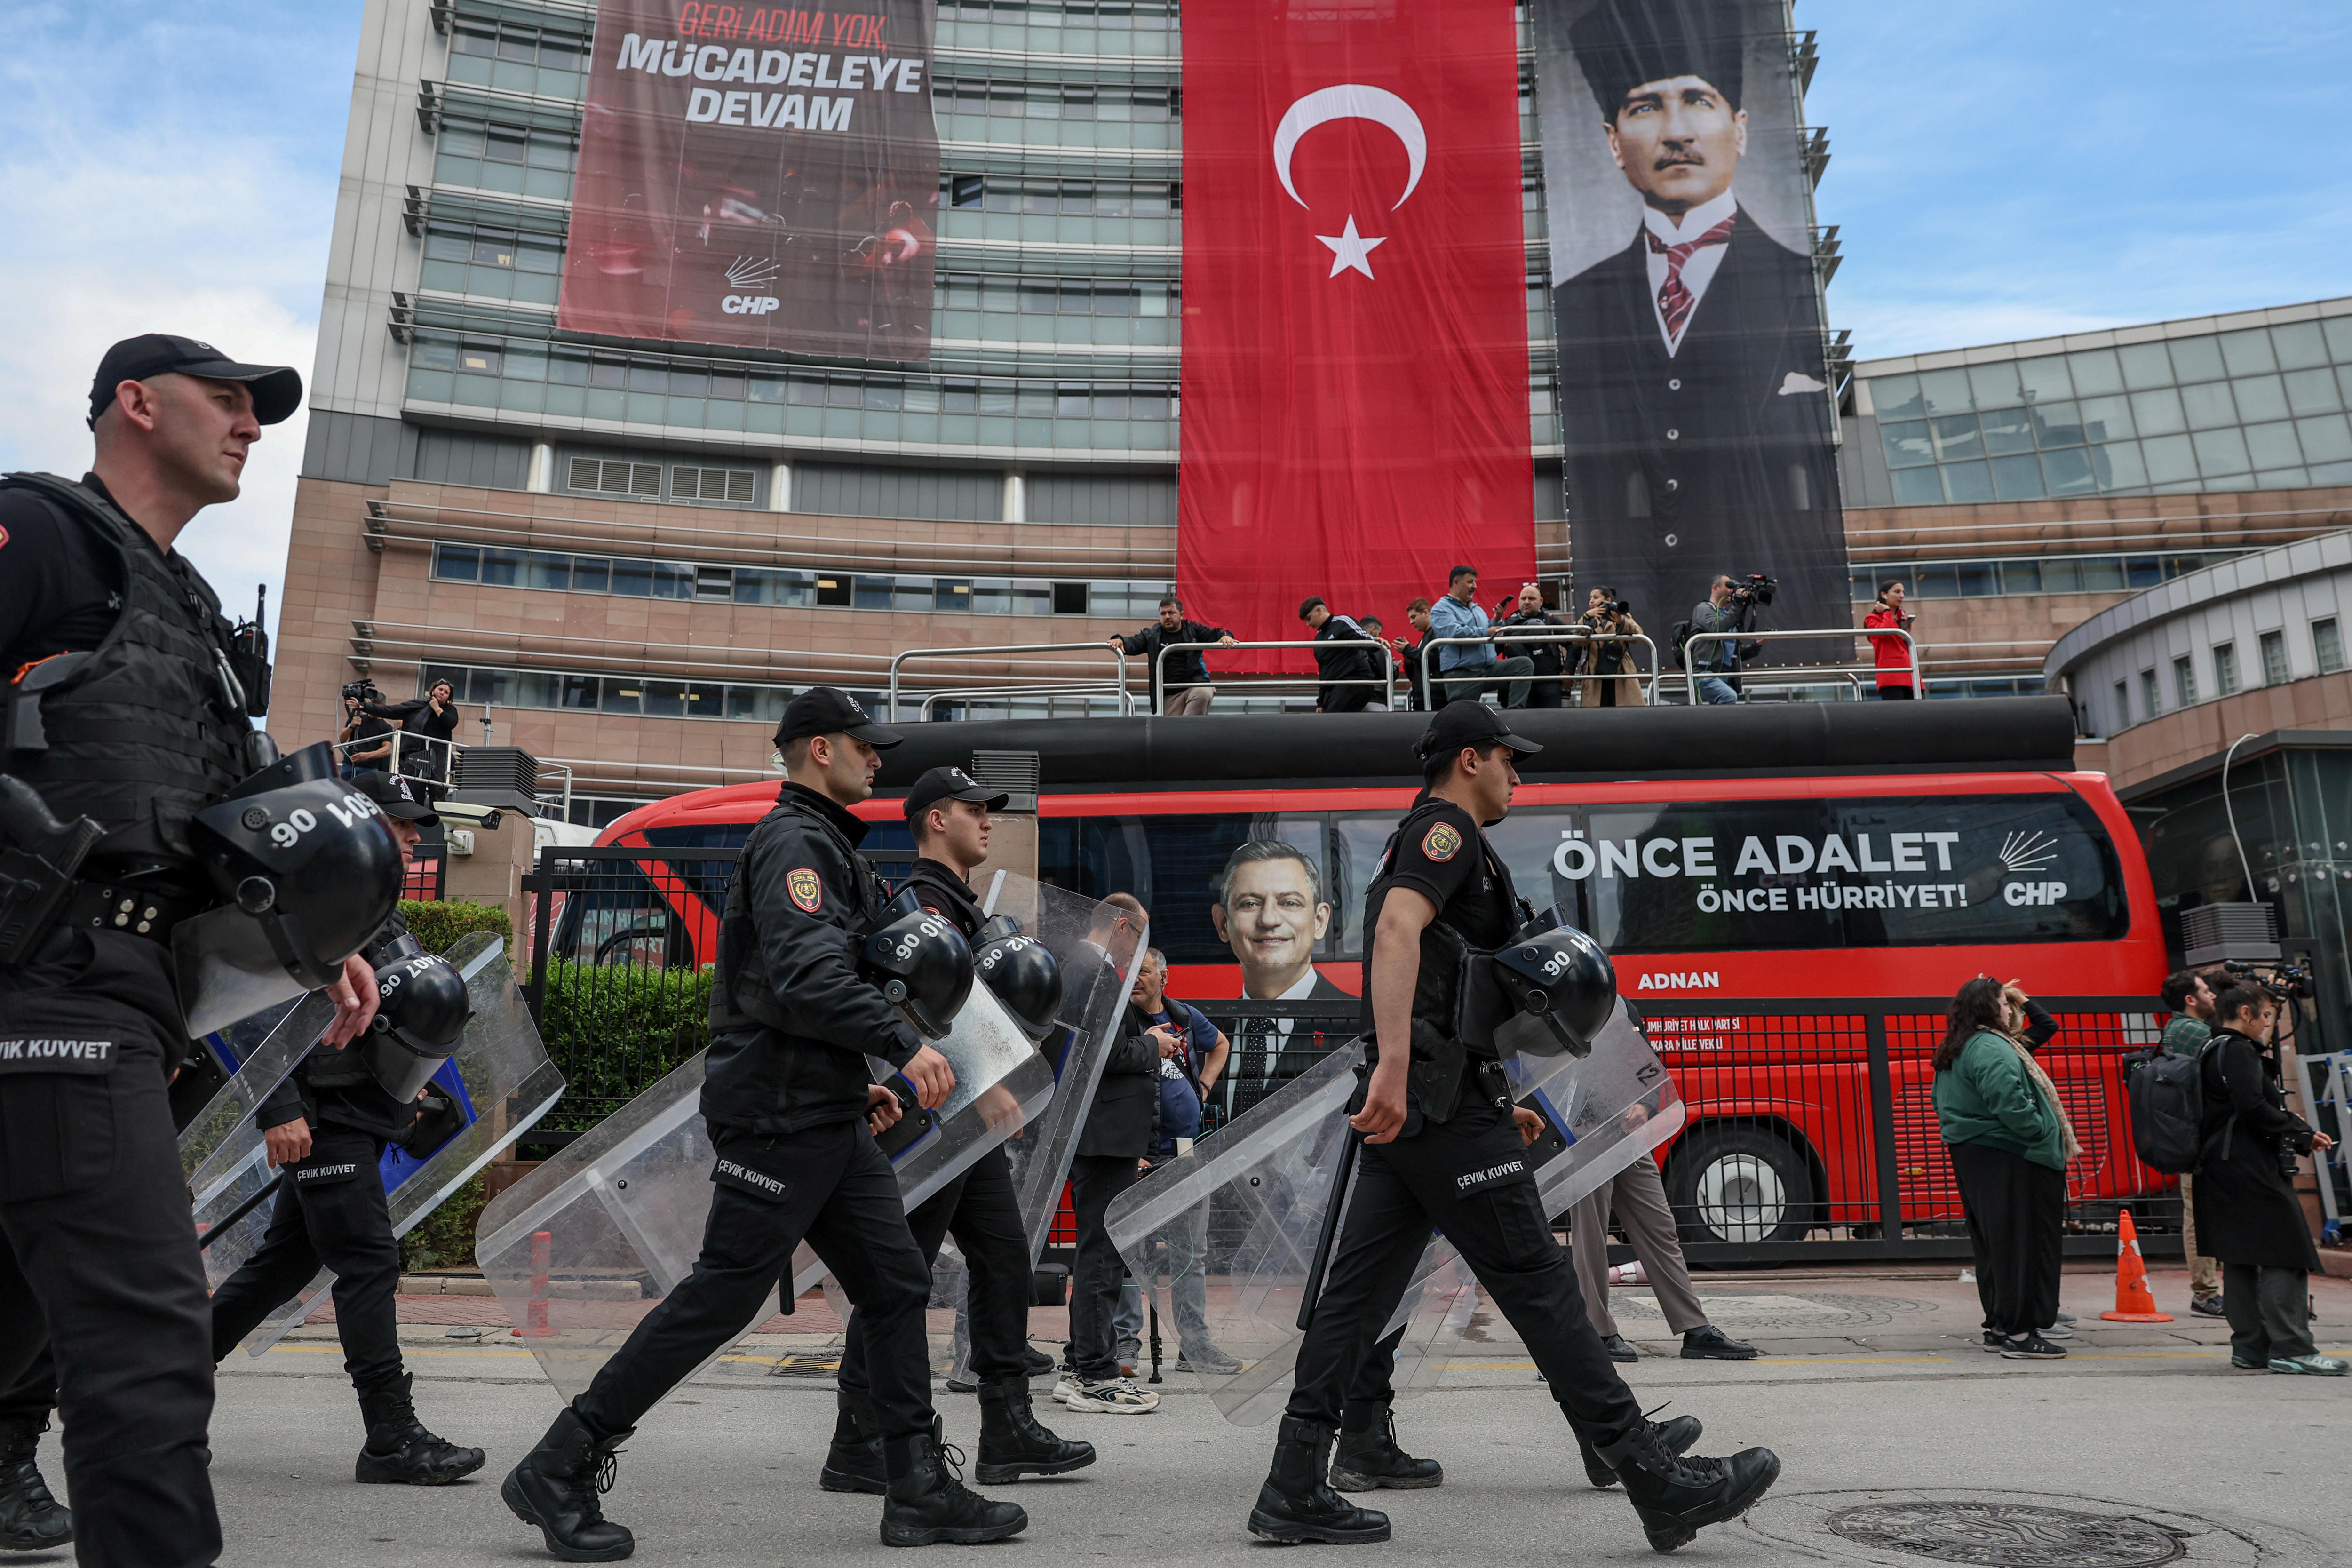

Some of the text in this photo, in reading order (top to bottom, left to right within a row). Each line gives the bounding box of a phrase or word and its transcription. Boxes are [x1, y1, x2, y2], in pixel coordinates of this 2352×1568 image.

[746, 8, 825, 45] ADIM
[834, 13, 887, 53] YOK,
[616, 33, 924, 93] MÜCADELEYE
[685, 87, 854, 132] DEVAM
[721, 295, 780, 315] CHP
[1553, 830, 1959, 879] ÖNCE ADALET
[1697, 880, 1967, 913] ÖNCE HÜRRİYET!
[2004, 882, 2067, 906] CHP
[1638, 972, 1719, 990] ADNAN
[27, 1040, 112, 1059] KUVVET
[297, 1164, 356, 1182] ÇEVİK KUVVET
[717, 1159, 786, 1195] ÇEVİK KUVVET
[1457, 1161, 1524, 1190] ÇEVİK KUVVET
